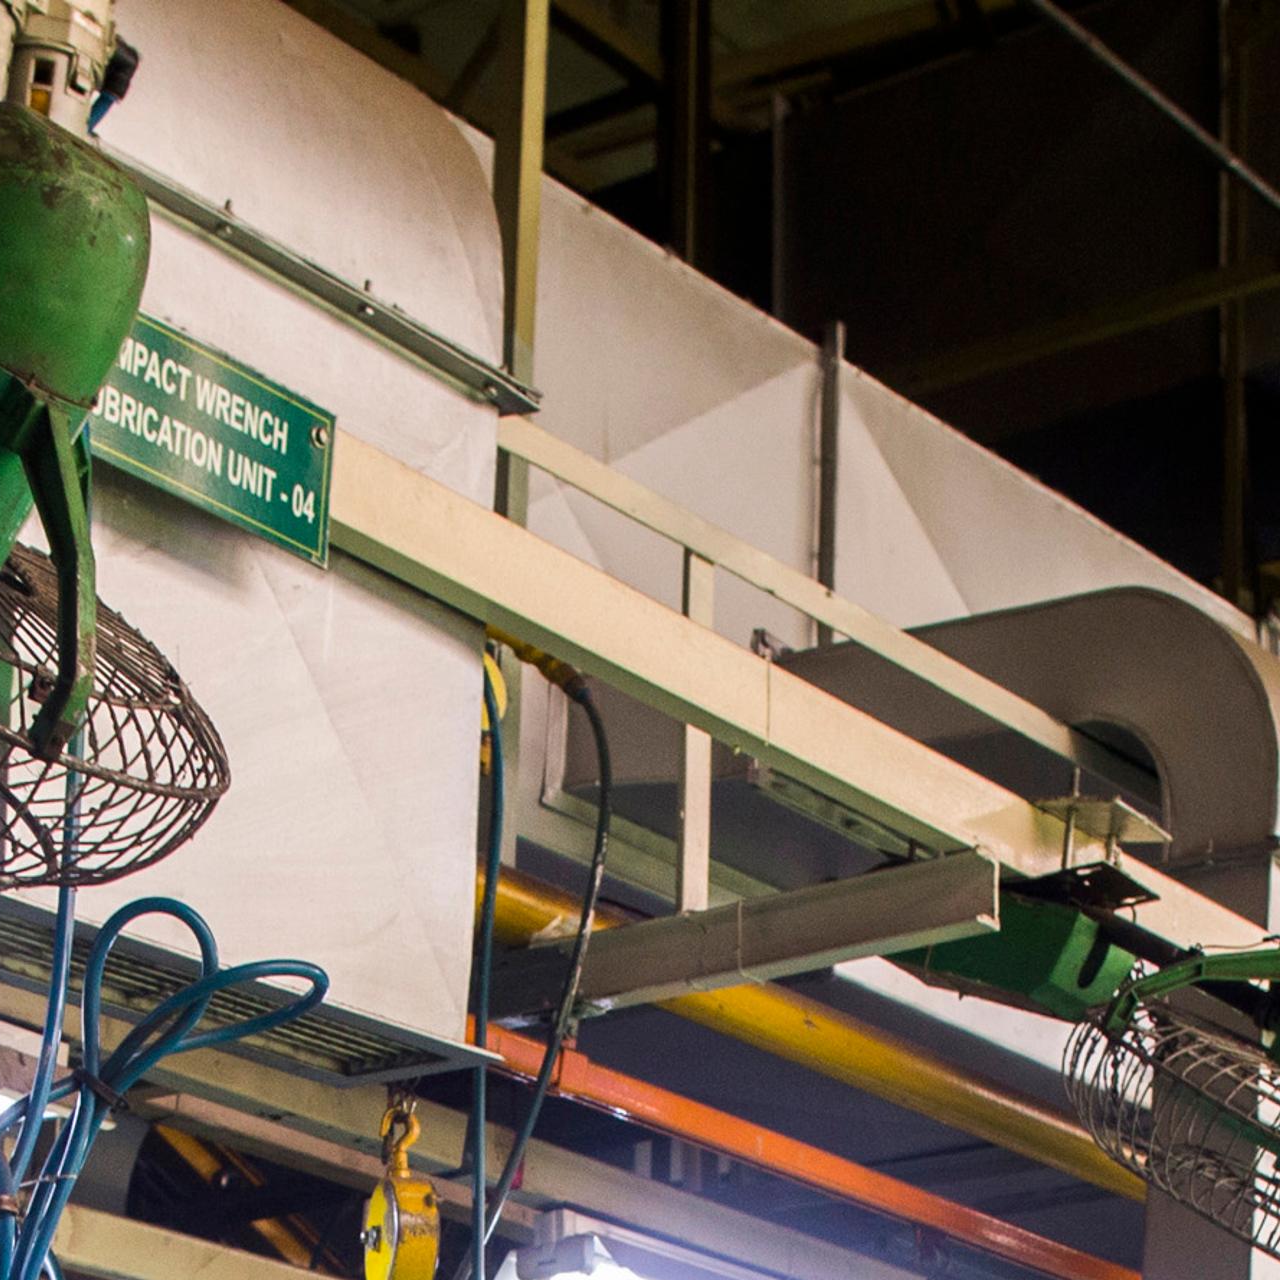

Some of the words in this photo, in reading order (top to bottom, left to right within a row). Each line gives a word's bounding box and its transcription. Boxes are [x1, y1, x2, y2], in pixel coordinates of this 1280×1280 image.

[92, 384, 223, 476] UBRICATION
[228, 448, 277, 502] UNIT
[291, 484, 316, 523] 04
[117, 338, 192, 401] MPACT
[196, 373, 289, 454] WRENCH
